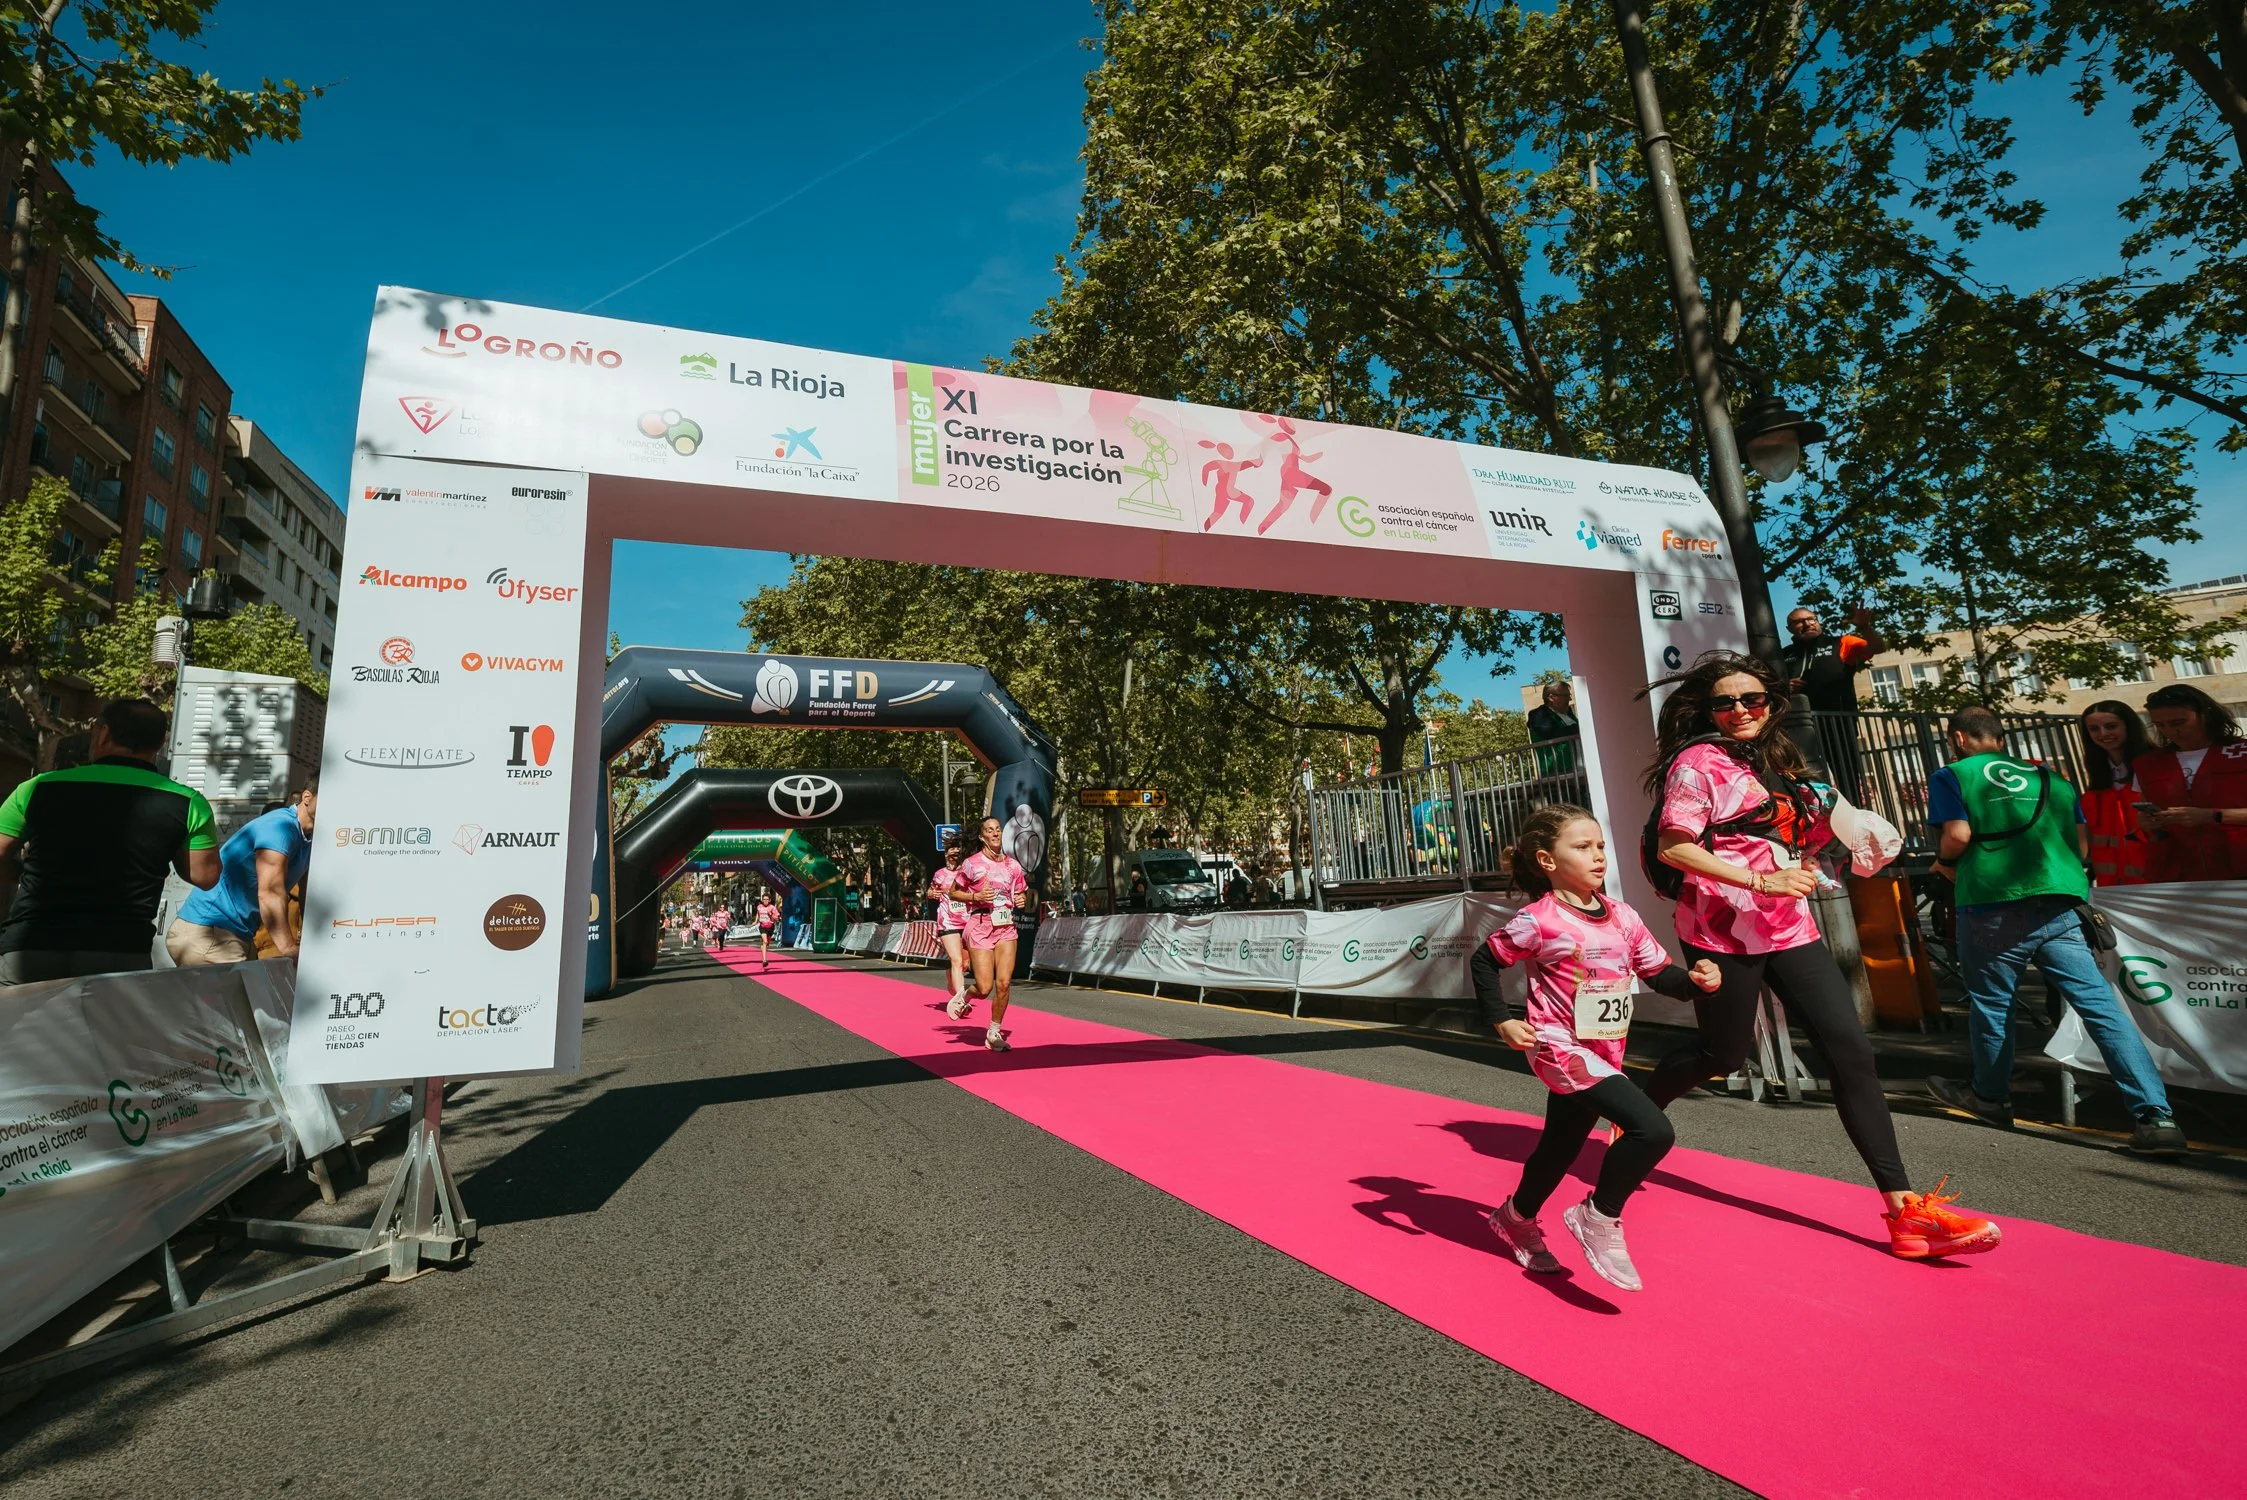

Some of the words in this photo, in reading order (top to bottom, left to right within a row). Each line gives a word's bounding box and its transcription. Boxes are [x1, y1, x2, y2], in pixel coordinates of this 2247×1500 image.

[438, 323, 623, 369] LOGROÑO
[729, 362, 762, 388] La
[771, 367, 845, 399] Rioja
[941, 386, 977, 415] XI
[906, 390, 939, 475] mujer
[944, 418, 1046, 449] Carrera
[1052, 435, 1095, 456] por
[1100, 438, 1124, 460] la
[736, 460, 802, 477] Fundación
[945, 445, 1122, 485] investigación
[947, 473, 1001, 492] 2026
[1653, 488, 1687, 501] HOUSE
[1378, 503, 1430, 517] asociación
[1432, 510, 1475, 523] española
[1381, 516, 1413, 528] contra
[1415, 519, 1424, 528] el
[1426, 520, 1458, 533] cáncer
[1384, 529, 1397, 538] en
[1399, 528, 1411, 539] La
[1413, 531, 1437, 544] Rioja
[1597, 531, 1642, 547] viamed
[358, 565, 467, 592] Alcampo
[487, 656, 563, 672] VIVAGYM
[810, 669, 879, 700] FFD
[809, 700, 851, 709] Fundación
[808, 709, 828, 717] para
[843, 709, 876, 718] Deporte
[506, 769, 553, 779] TEMPLO
[335, 826, 431, 848] garnica
[481, 831, 560, 848] ARNAUT
[363, 849, 398, 857] Challenge
[412, 849, 442, 857] ordinary
[489, 915, 540, 926] delicatto
[999, 911, 1008, 920] 70
[331, 928, 436, 939] coatings
[1586, 968, 1597, 978] XI
[2186, 964, 2247, 977] asocia
[328, 992, 385, 1019] 100
[1597, 996, 1629, 1023] 236
[2187, 997, 2209, 1007] en
[2215, 996, 2239, 1009] La
[438, 1003, 519, 1029] tacto
[327, 1024, 355, 1032] PASEO
[325, 1041, 365, 1050] TIENDAS
[326, 1033, 337, 1042] DE
[339, 1032, 356, 1041] LAS
[357, 1032, 380, 1040] CIEN
[0, 1113, 53, 1143] ociación
[156, 1117, 168, 1131] en
[39, 1135, 52, 1155] el
[51, 1124, 88, 1150] cáncer
